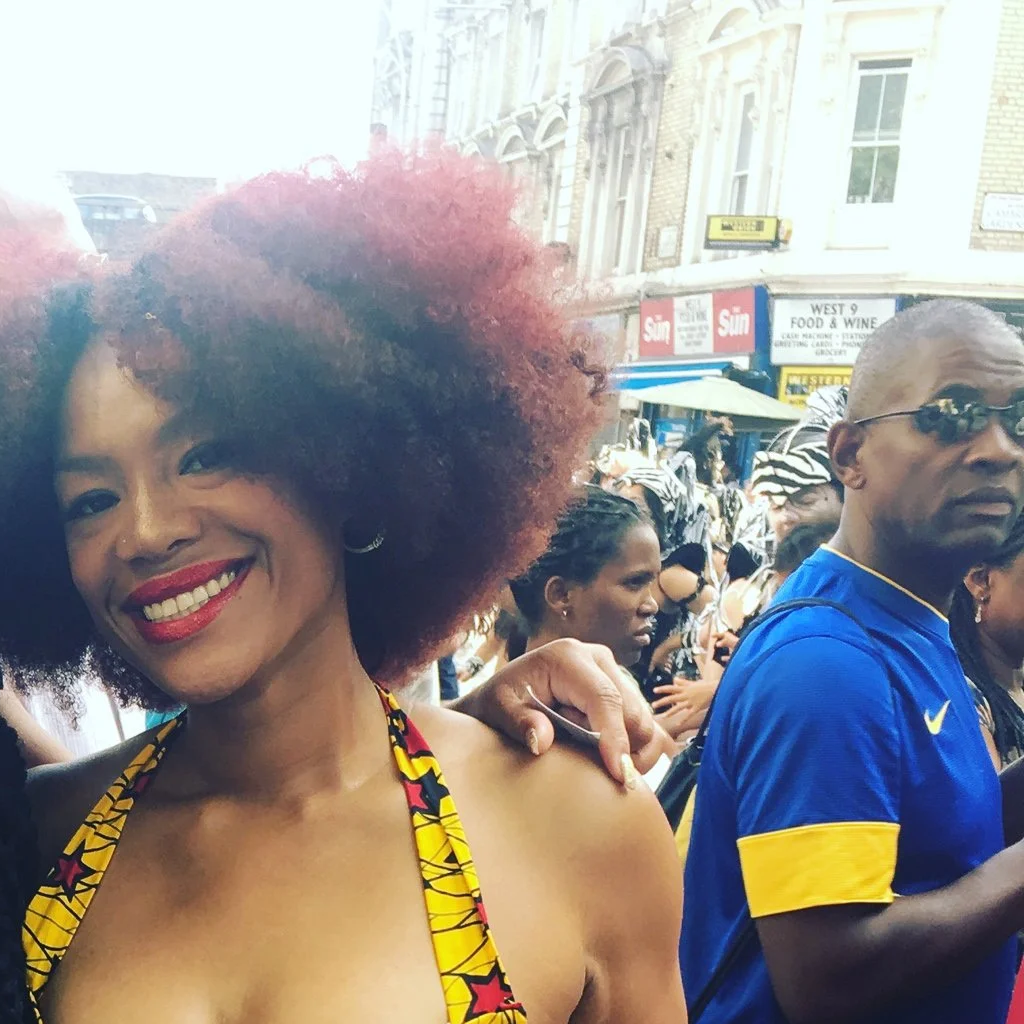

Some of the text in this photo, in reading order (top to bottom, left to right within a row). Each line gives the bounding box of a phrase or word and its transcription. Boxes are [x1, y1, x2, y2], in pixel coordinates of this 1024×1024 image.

[810, 303, 858, 315] WEST 9
[643, 316, 671, 345] Sun
[717, 308, 750, 336] Sun
[790, 317, 878, 329] FOOD & WINE
